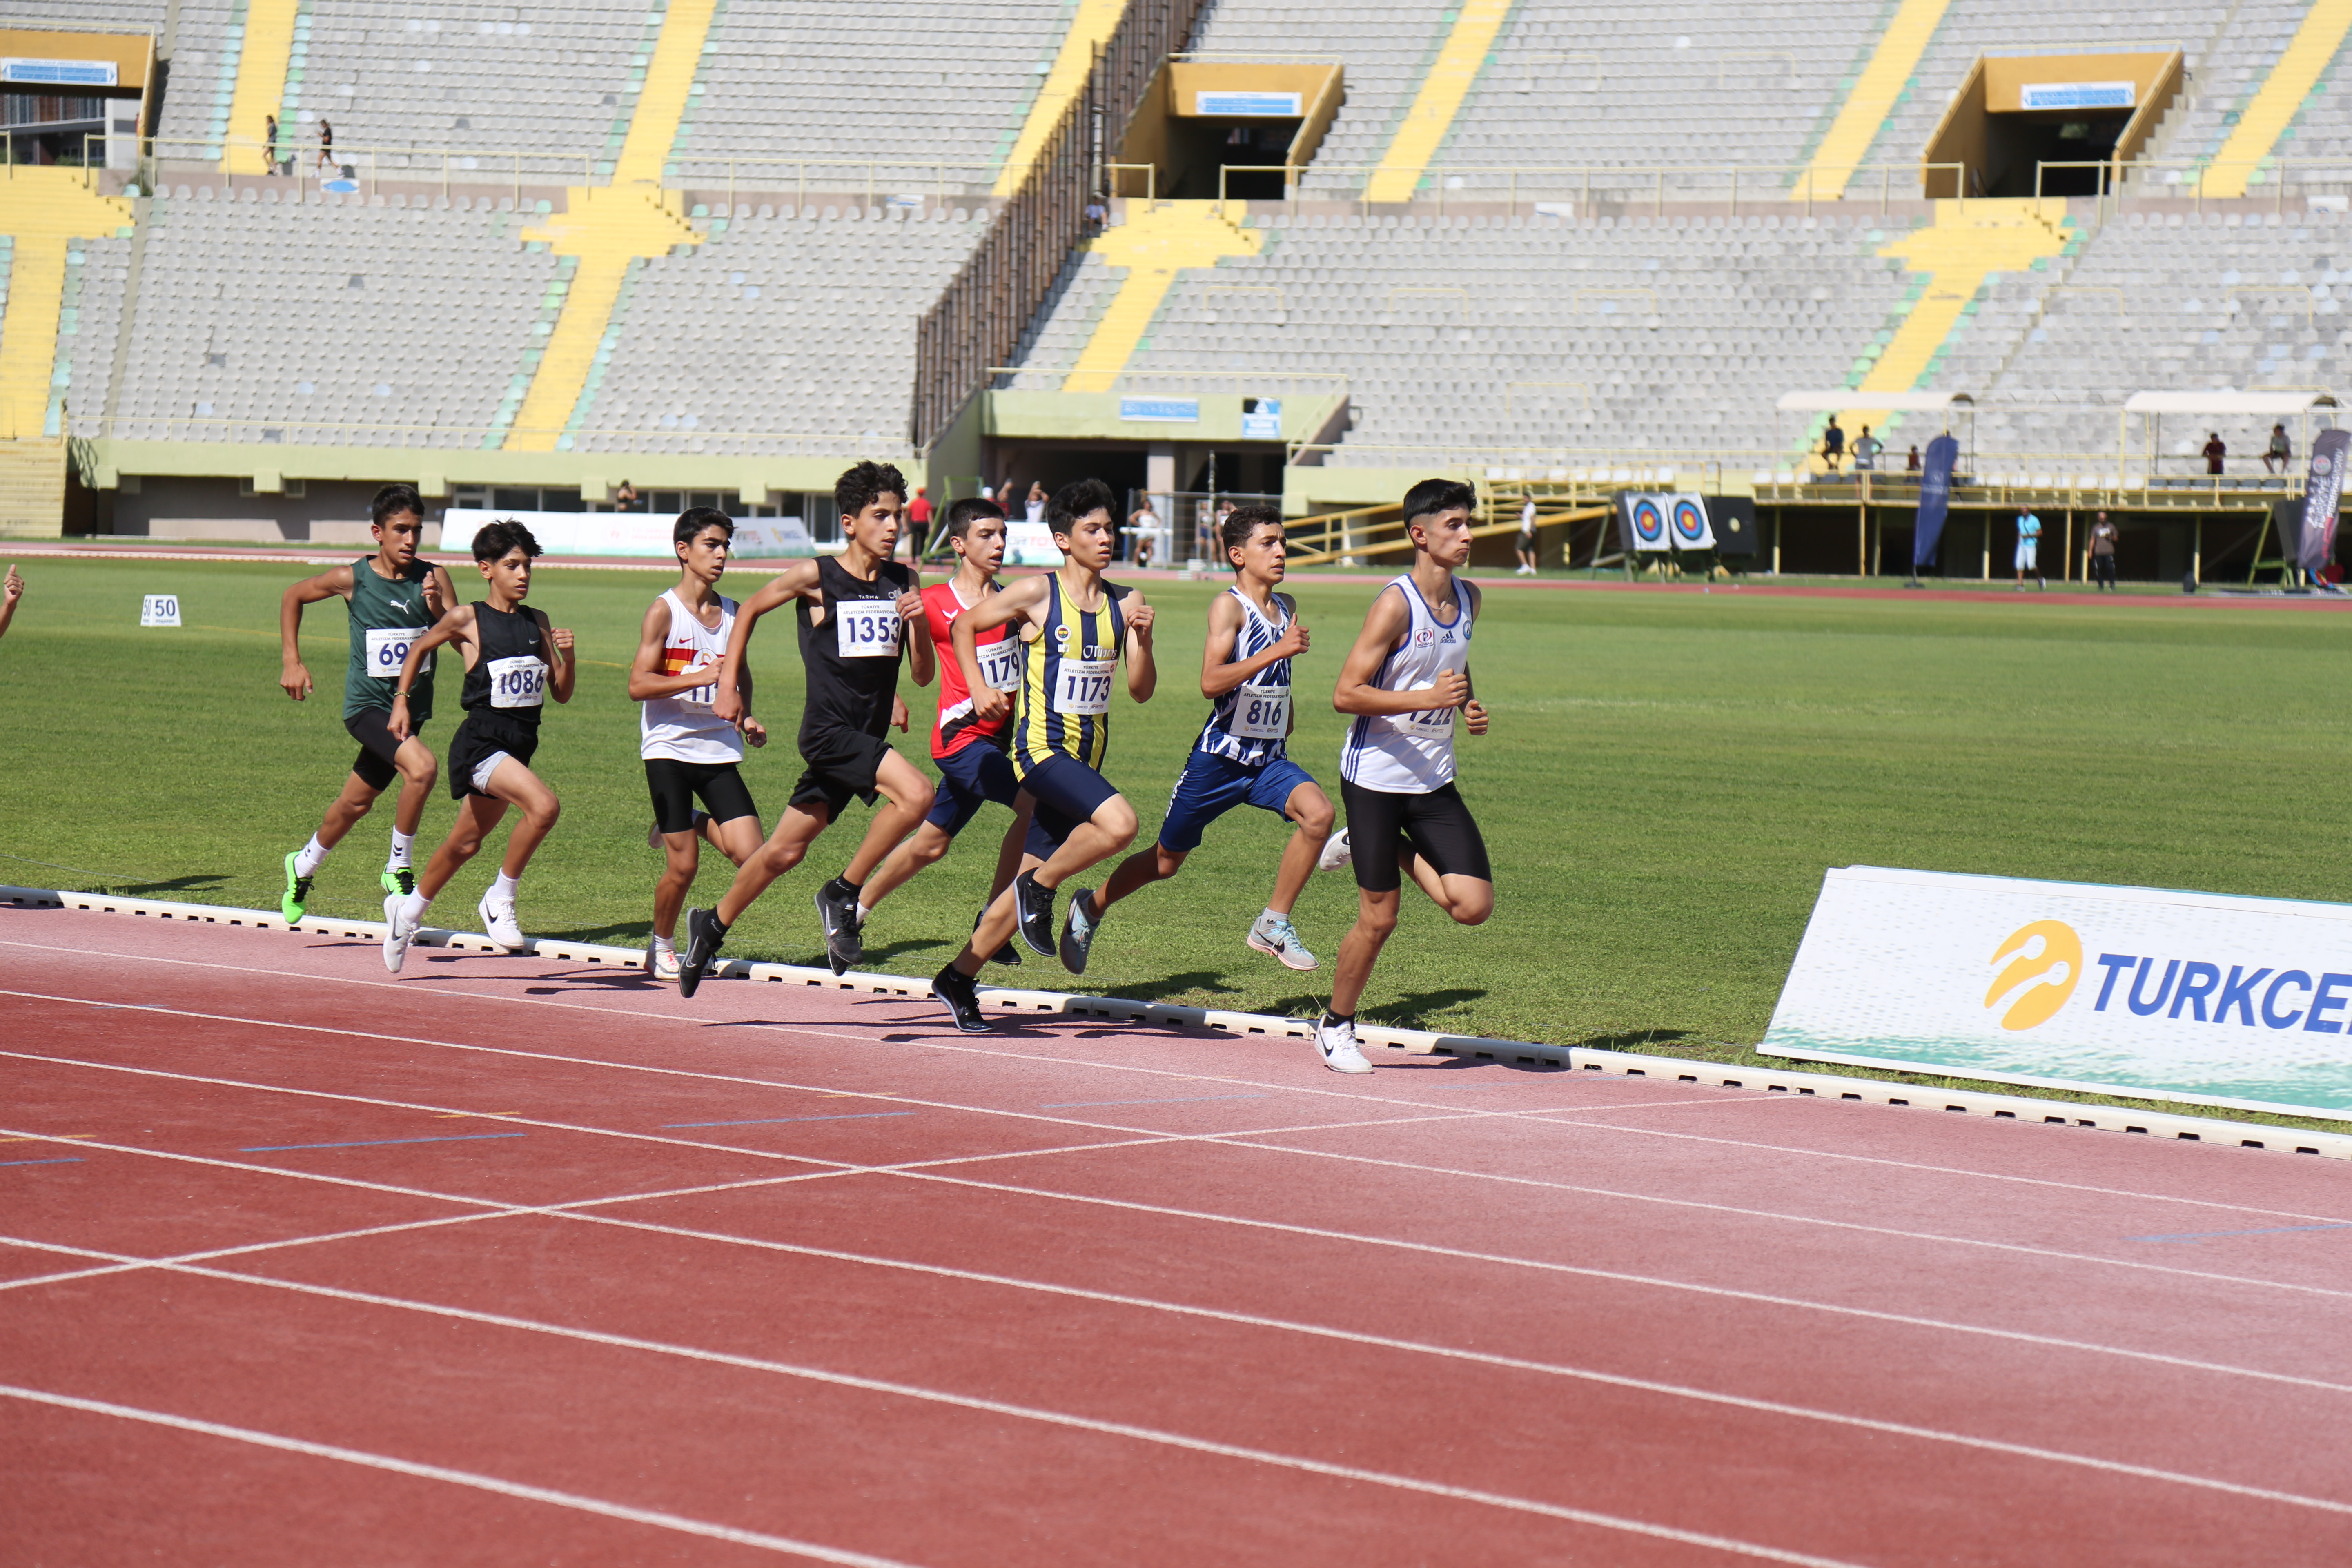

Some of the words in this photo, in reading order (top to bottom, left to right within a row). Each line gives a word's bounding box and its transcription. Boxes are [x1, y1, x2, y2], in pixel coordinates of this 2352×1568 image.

[155, 599, 176, 617] 50
[846, 616, 900, 644] 1353
[379, 642, 413, 666] 69
[499, 669, 544, 695] 1086
[1067, 675, 1111, 702] 1173
[1247, 699, 1283, 726] 816
[2094, 953, 2352, 1035] TURKCE
